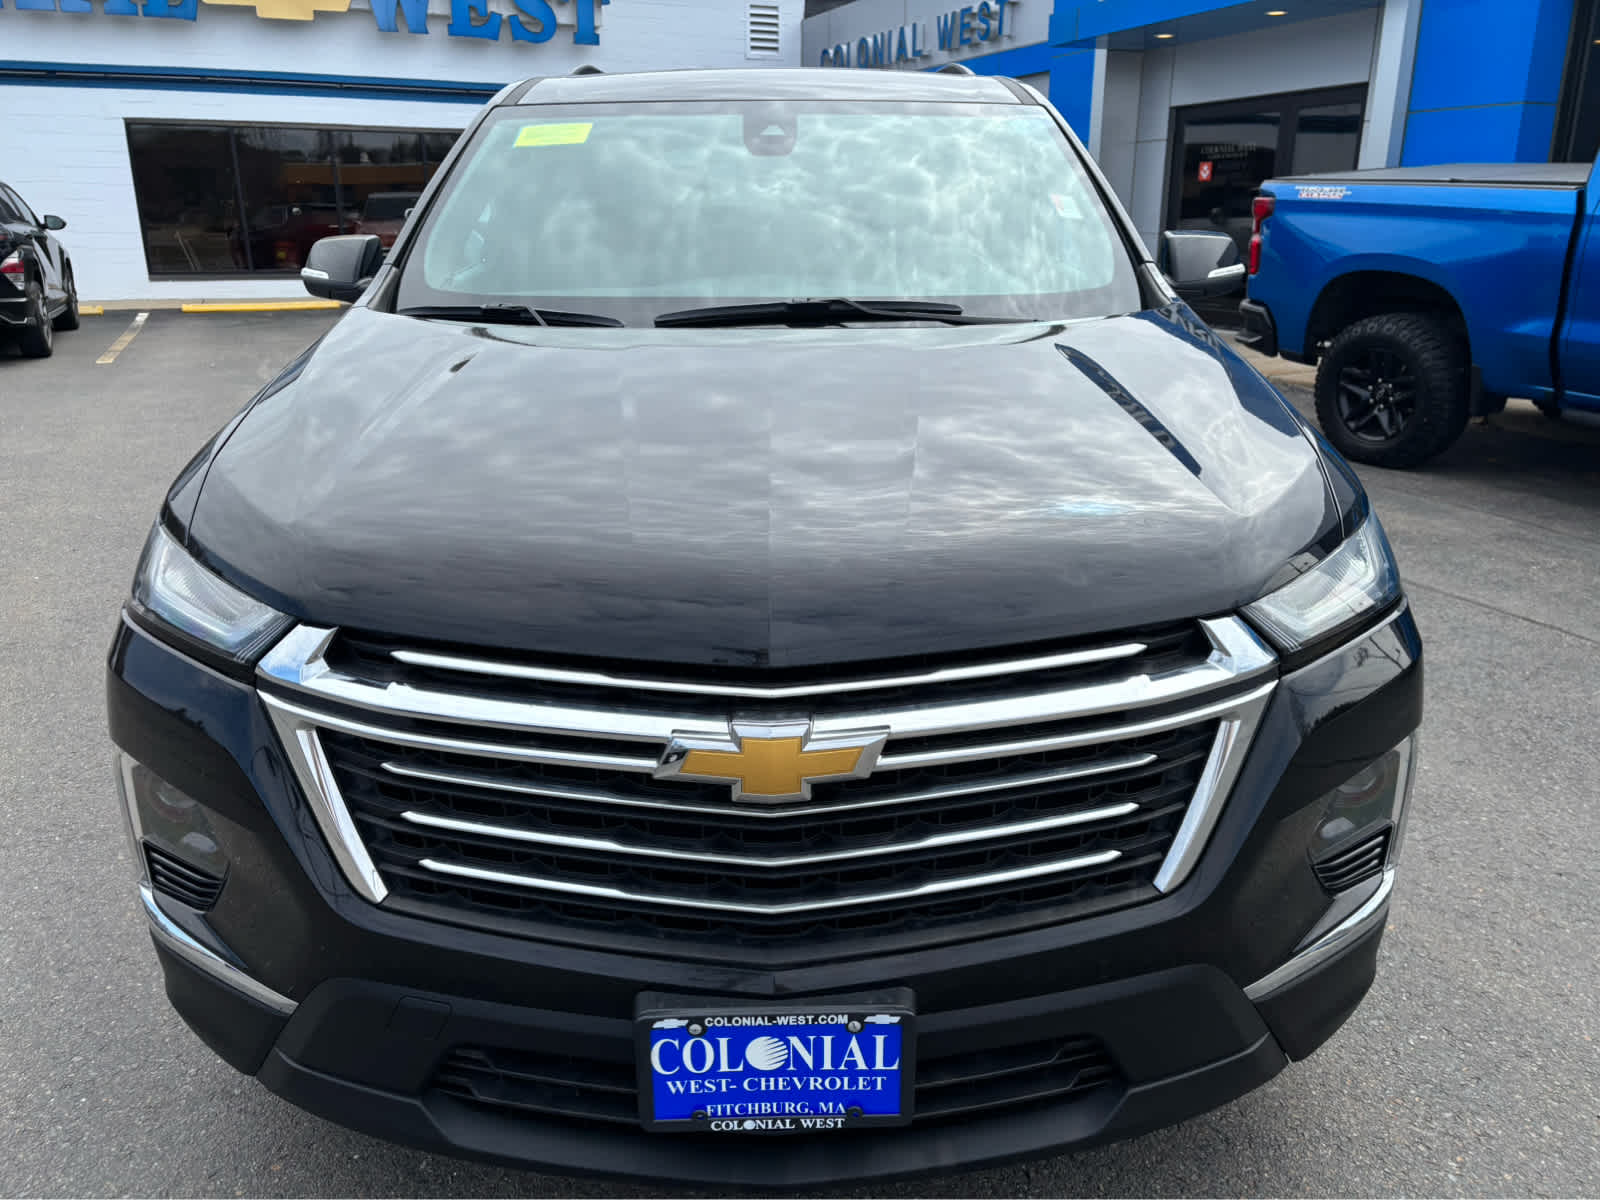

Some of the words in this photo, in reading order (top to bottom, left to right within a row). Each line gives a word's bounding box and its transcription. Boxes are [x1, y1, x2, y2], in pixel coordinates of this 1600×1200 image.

[936, 0, 1009, 51] WEST
[704, 1014, 849, 1027] COLONIAL-WEST.COM
[742, 1076, 887, 1092] CHEVROLET
[706, 1101, 814, 1117] FITCHBURG,
[818, 1101, 846, 1114] MA
[800, 1118, 846, 1129] WEST
